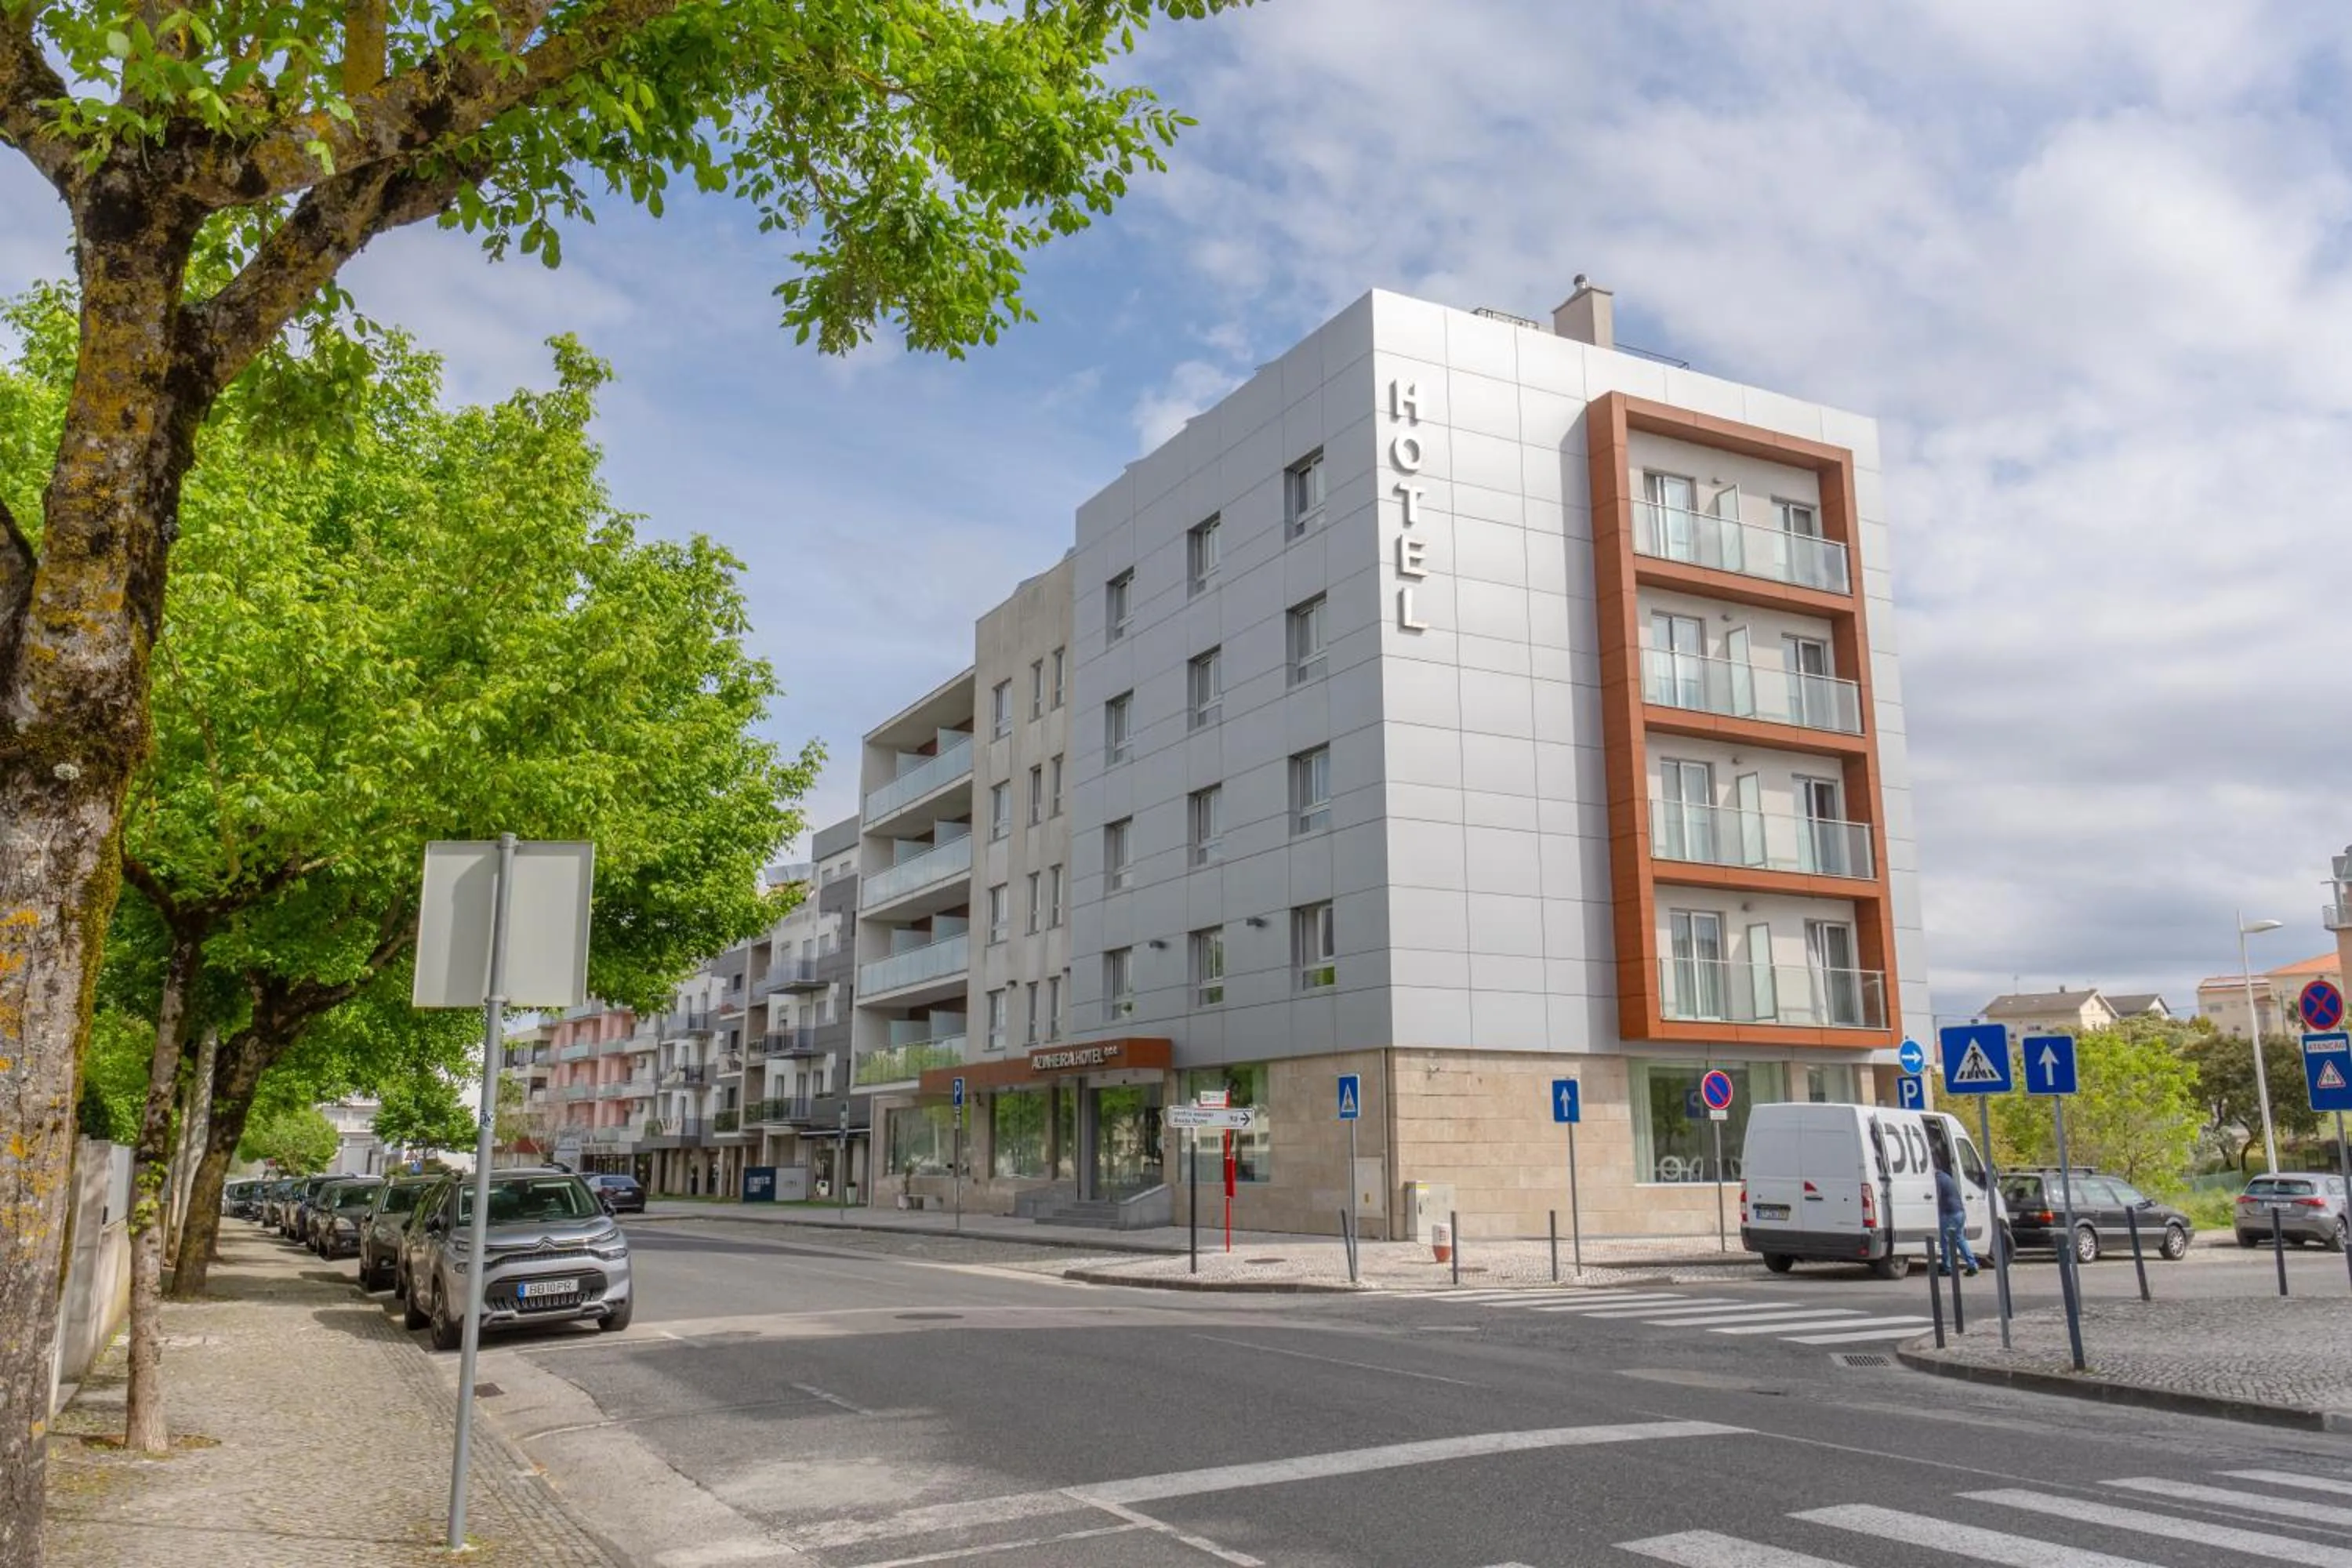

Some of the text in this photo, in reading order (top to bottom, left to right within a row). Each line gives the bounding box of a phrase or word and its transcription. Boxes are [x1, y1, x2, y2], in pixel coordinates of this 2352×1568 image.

[1390, 379, 1428, 635] HOTEL
[954, 1081, 960, 1103] P
[1902, 1080, 1918, 1109] P
